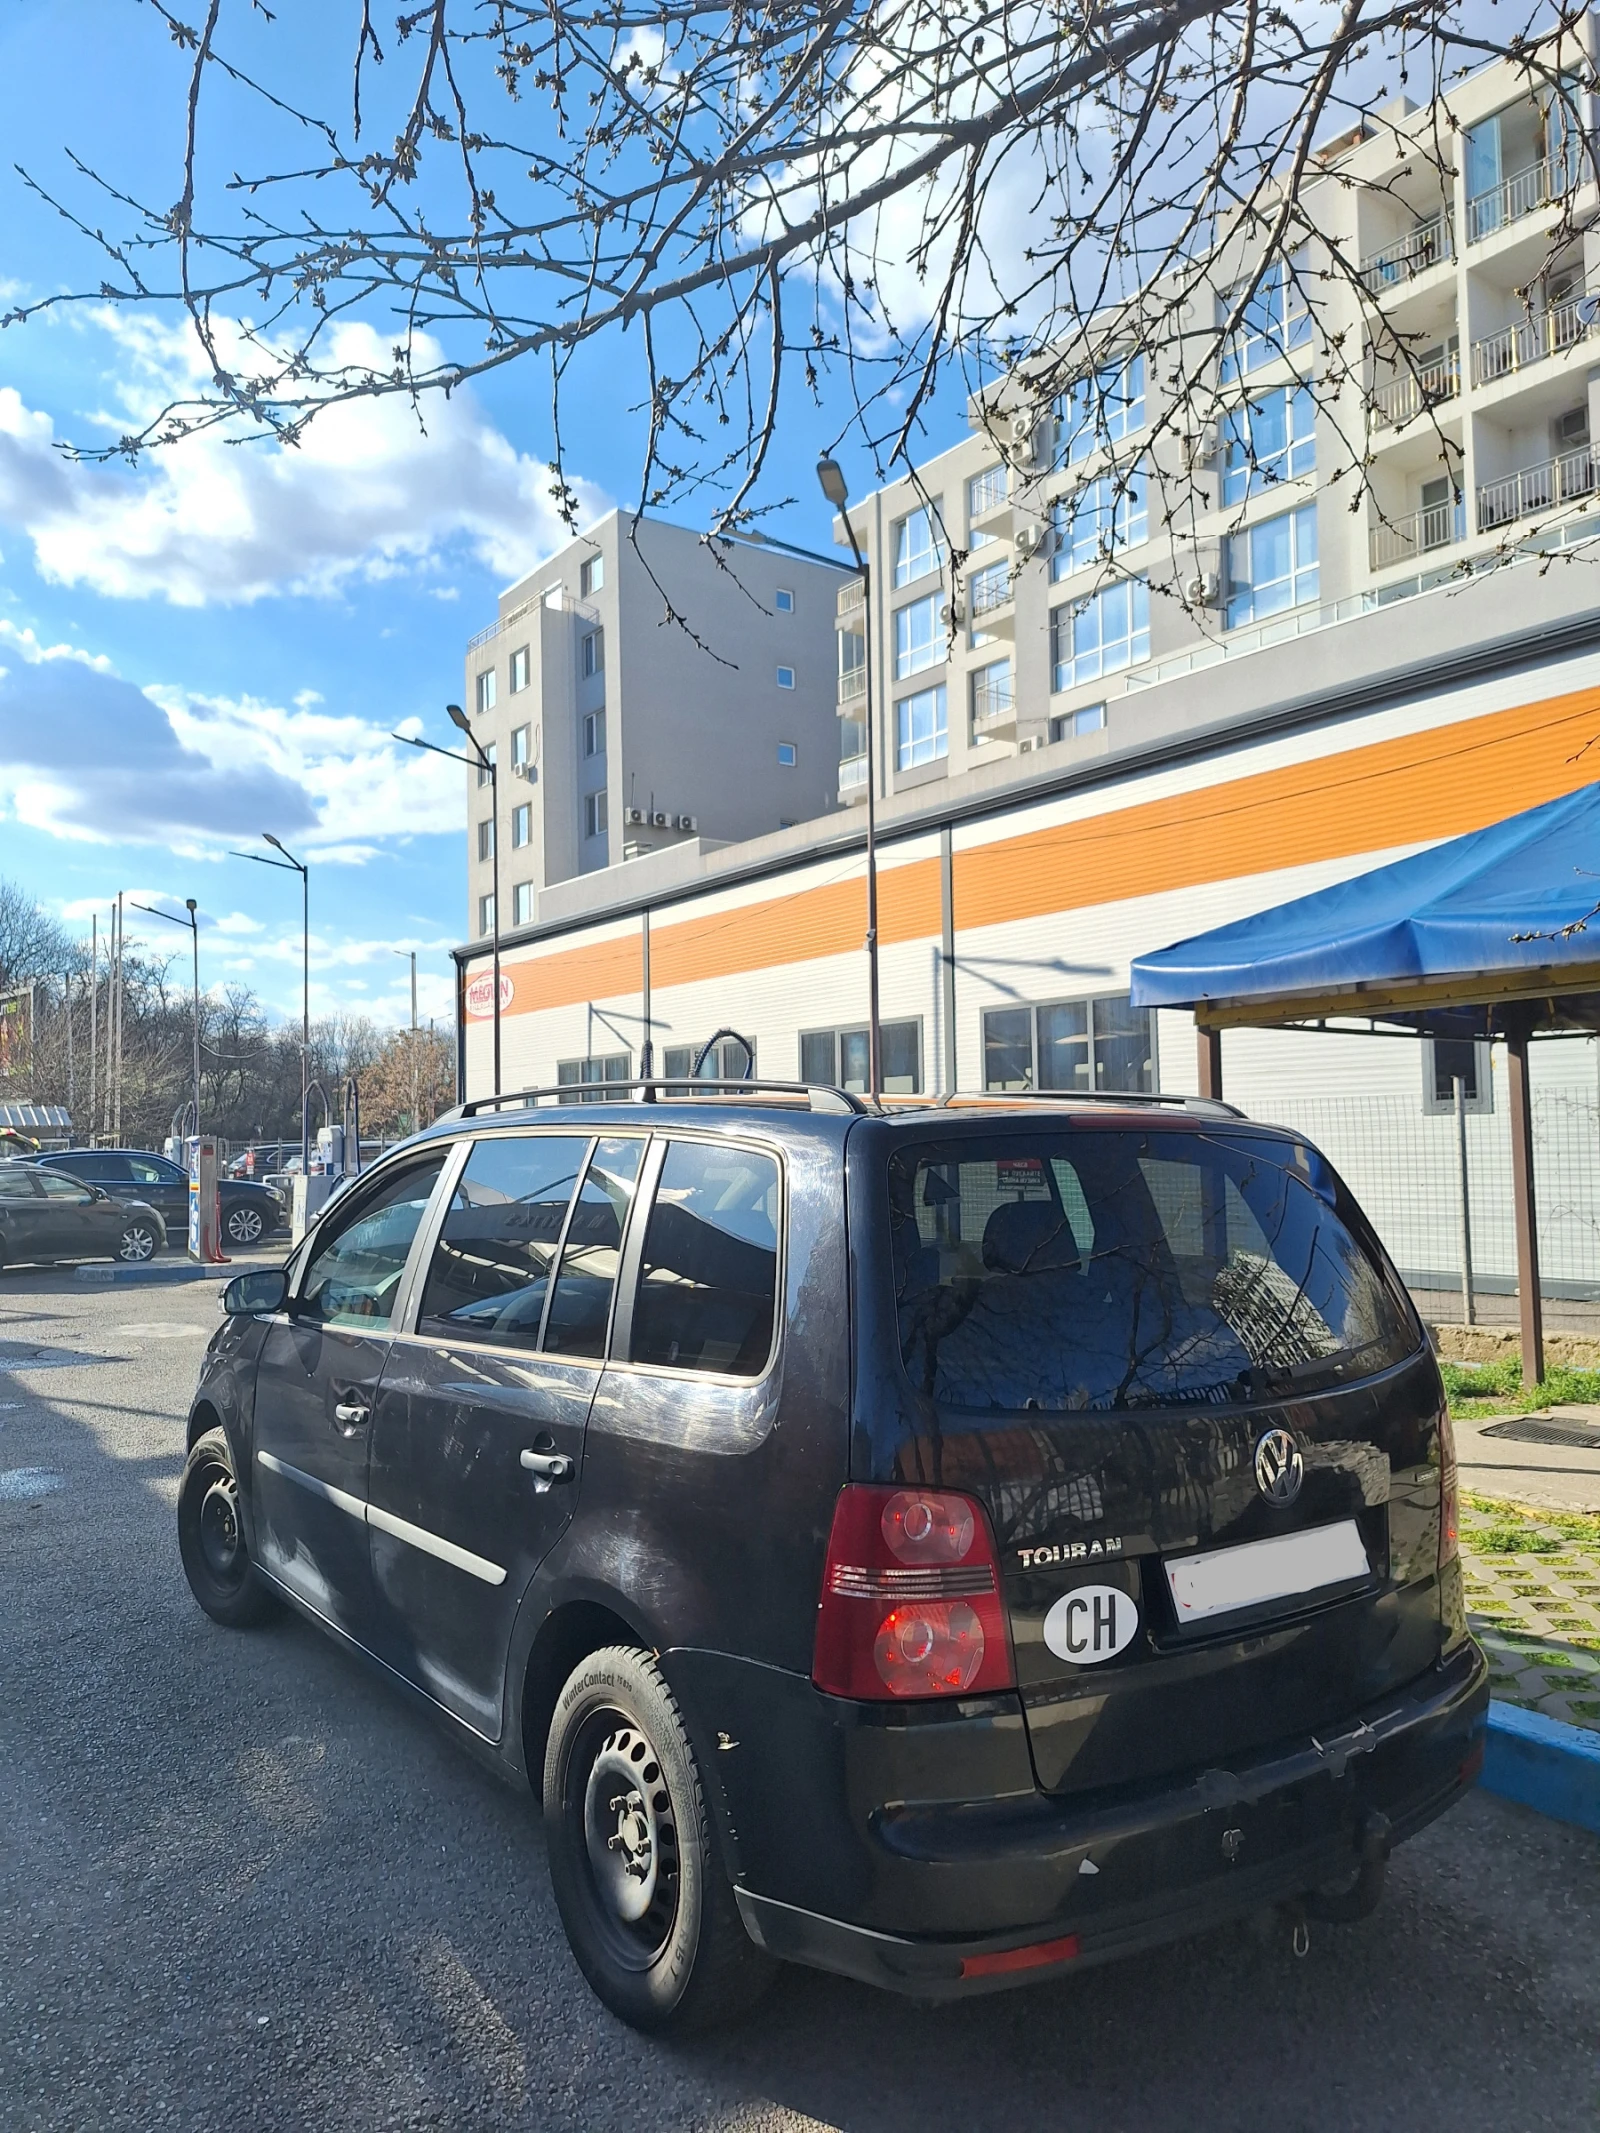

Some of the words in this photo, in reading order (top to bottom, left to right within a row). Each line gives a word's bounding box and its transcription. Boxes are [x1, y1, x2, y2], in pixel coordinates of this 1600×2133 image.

[1018, 1537, 1122, 1568] TOURAN
[1066, 1594, 1116, 1653] CH
[562, 1671, 615, 1711] WinterContact
